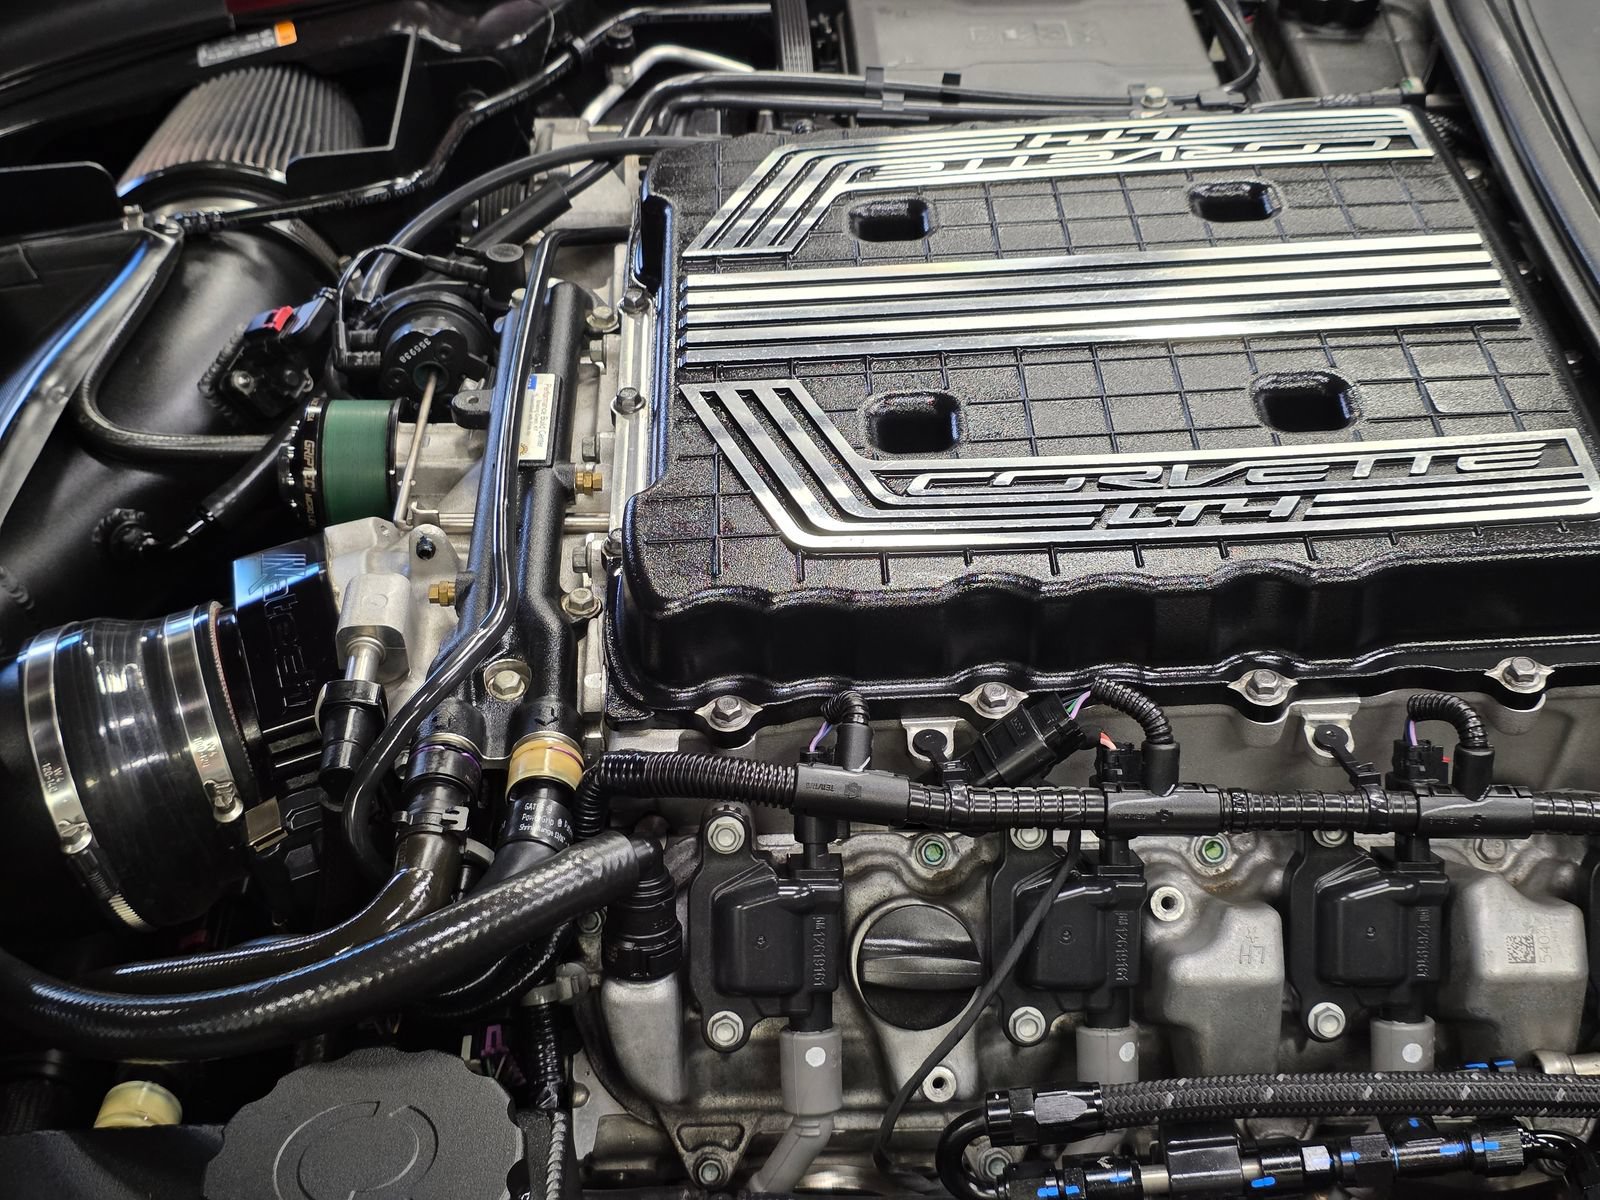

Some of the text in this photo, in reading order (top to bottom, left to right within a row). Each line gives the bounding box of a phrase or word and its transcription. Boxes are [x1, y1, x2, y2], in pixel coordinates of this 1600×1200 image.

[1026, 124, 1179, 149] LT4
[872, 140, 1392, 178] CORVETTE
[536, 430, 547, 448] Center
[303, 440, 316, 489] GRIPTEC
[904, 442, 1547, 496] CORVETTE
[1106, 496, 1302, 529] LT4
[524, 802, 545, 811] GATS
